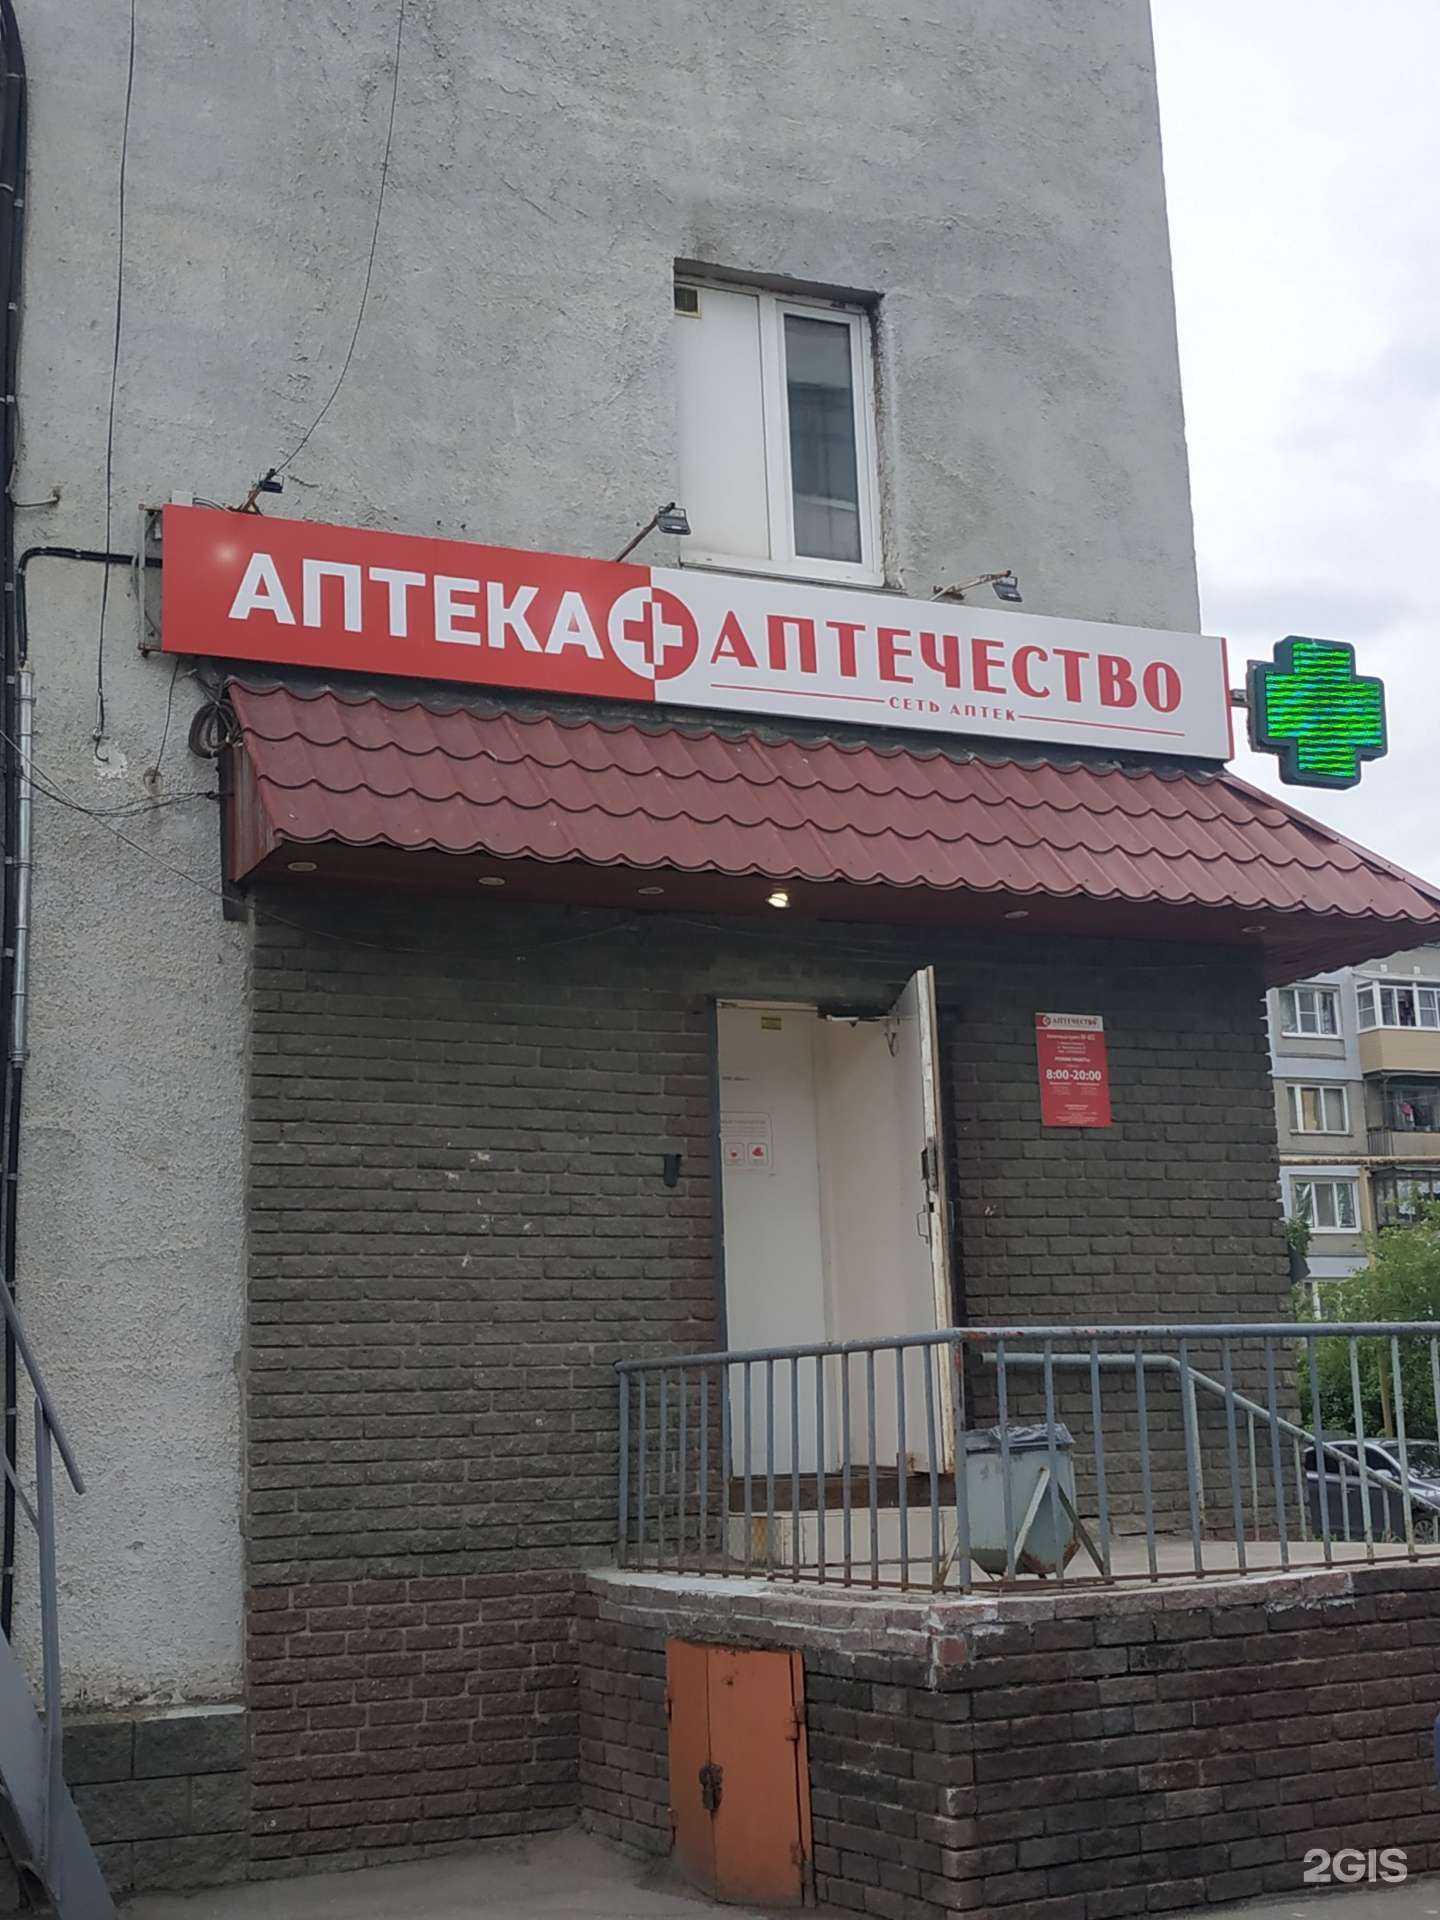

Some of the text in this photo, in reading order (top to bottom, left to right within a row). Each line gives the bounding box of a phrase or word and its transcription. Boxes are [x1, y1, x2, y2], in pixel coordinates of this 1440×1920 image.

[228, 552, 1182, 714] АПТЕКА АПТЕЧЕСТВО
[888, 697, 1017, 722] СЕТЬ АПТЕК
